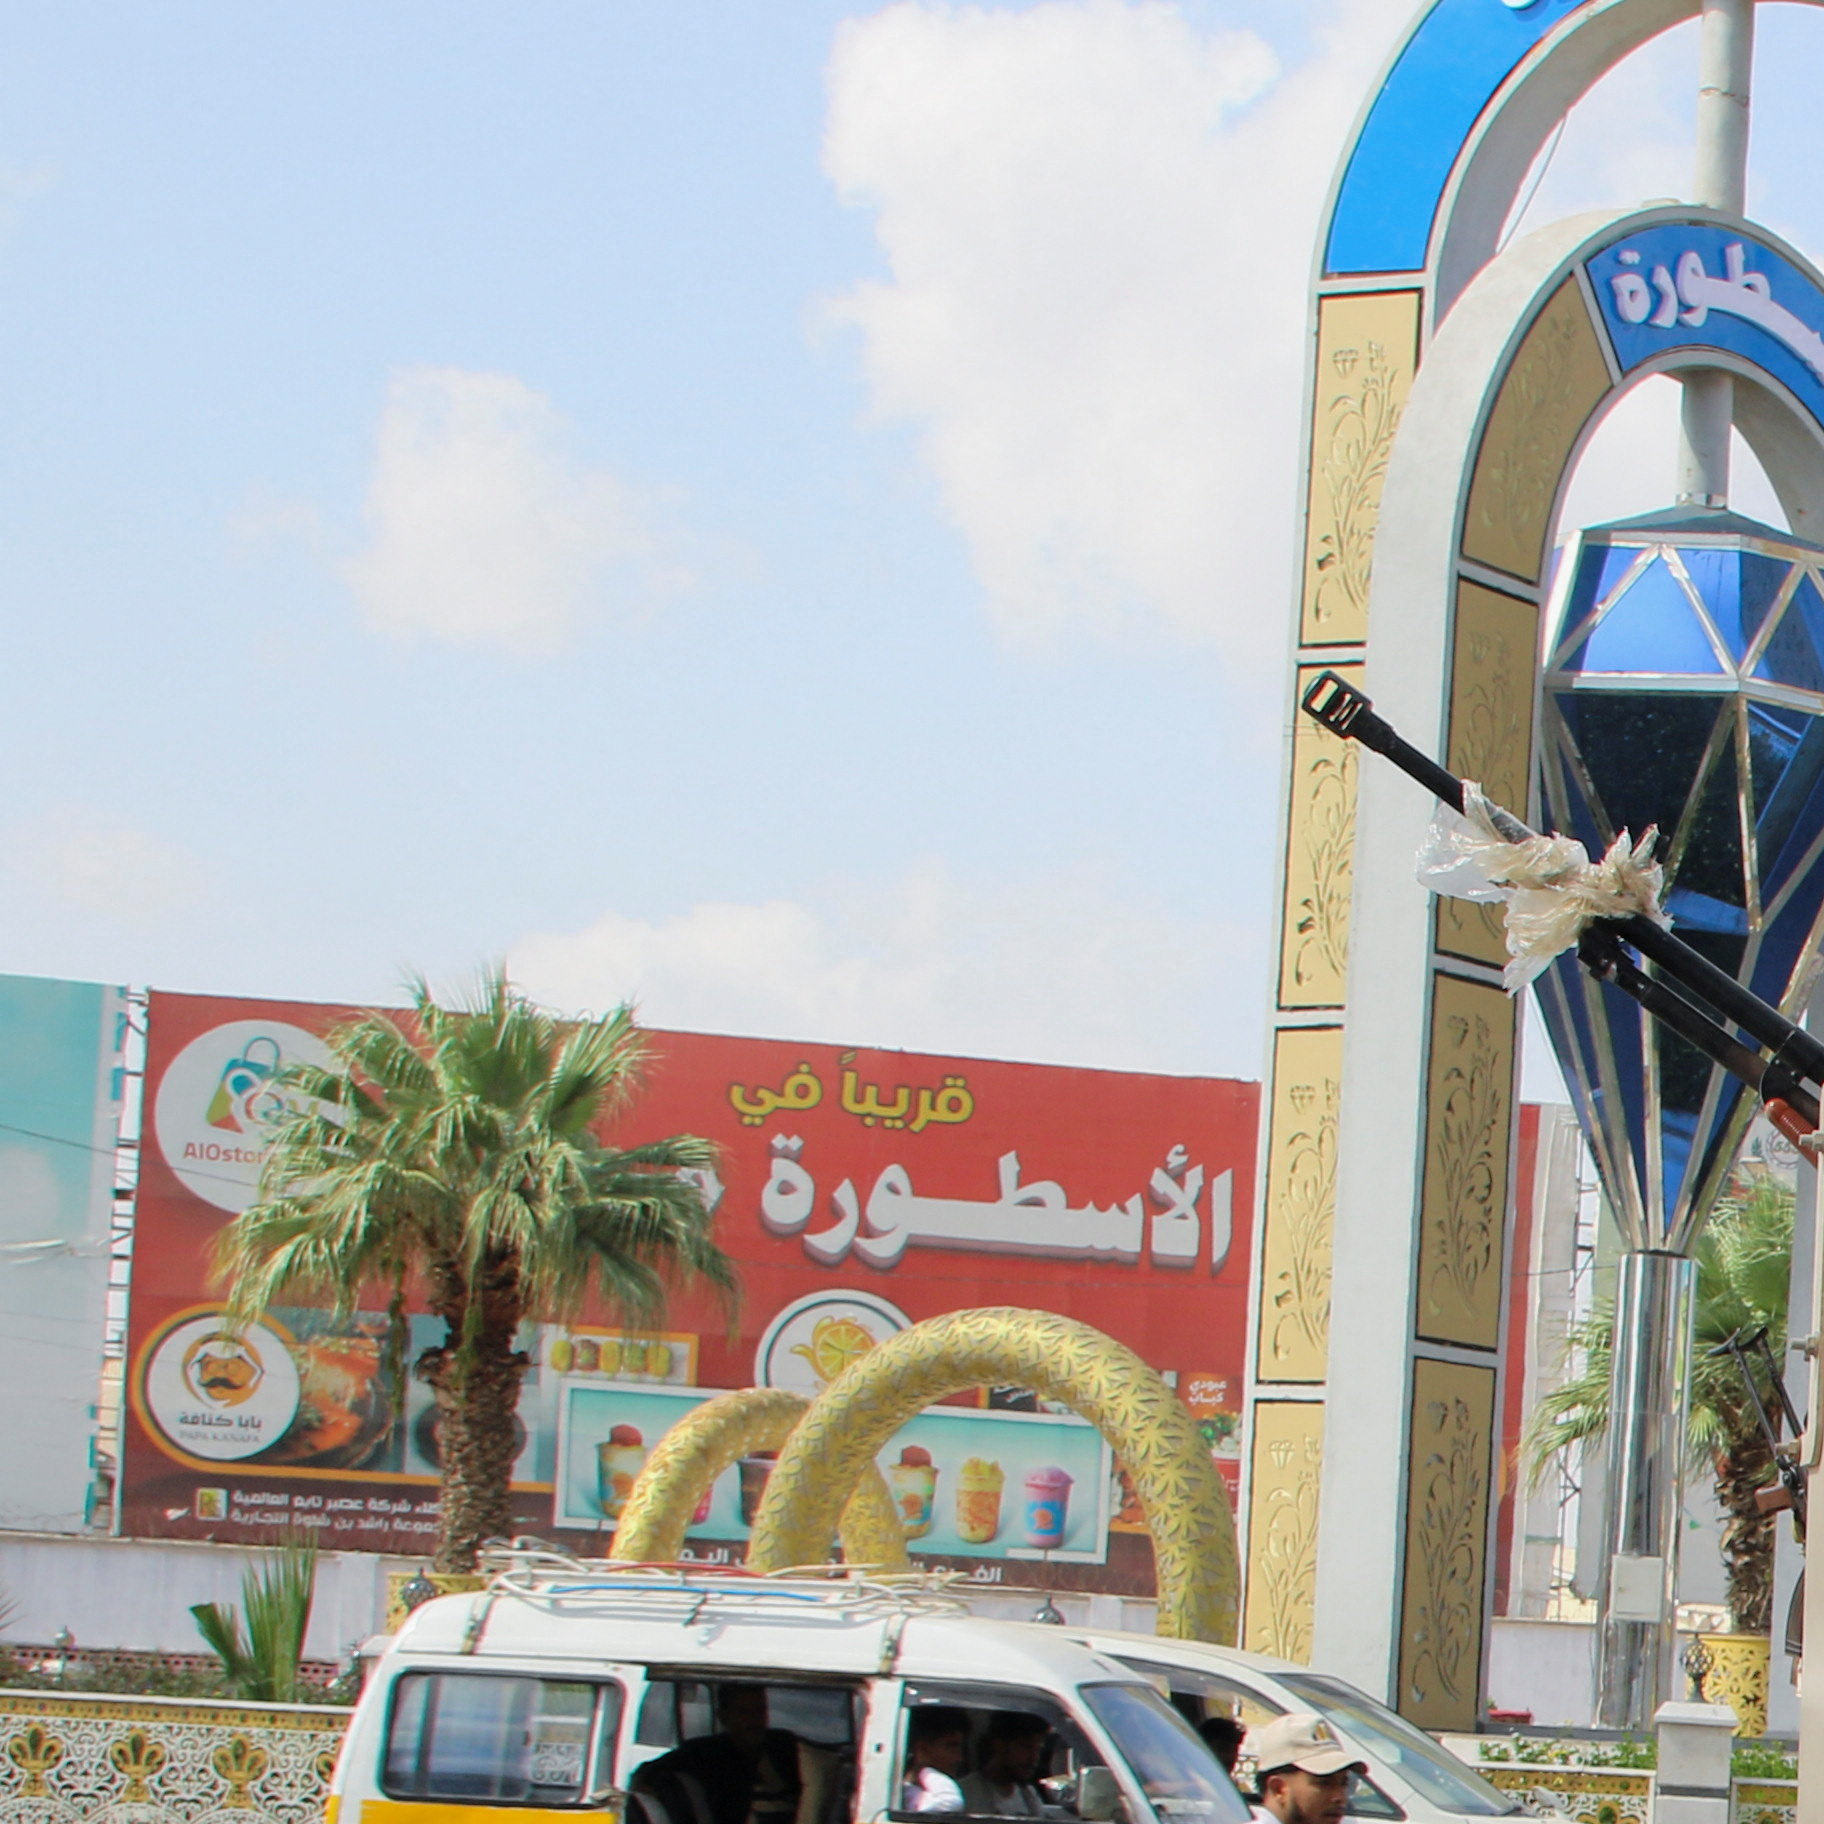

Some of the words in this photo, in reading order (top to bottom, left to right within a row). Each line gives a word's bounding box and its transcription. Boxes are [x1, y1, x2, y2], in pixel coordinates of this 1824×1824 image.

[728, 1061, 824, 1127] في
[183, 1141, 267, 1164] AlOstor
[760, 1133, 1236, 1268] الأسطورة
[179, 1410, 234, 1427] كنافة
[232, 1489, 290, 1506] العالمية
[325, 1497, 365, 1512] عصير
[367, 1496, 412, 1515] شركة
